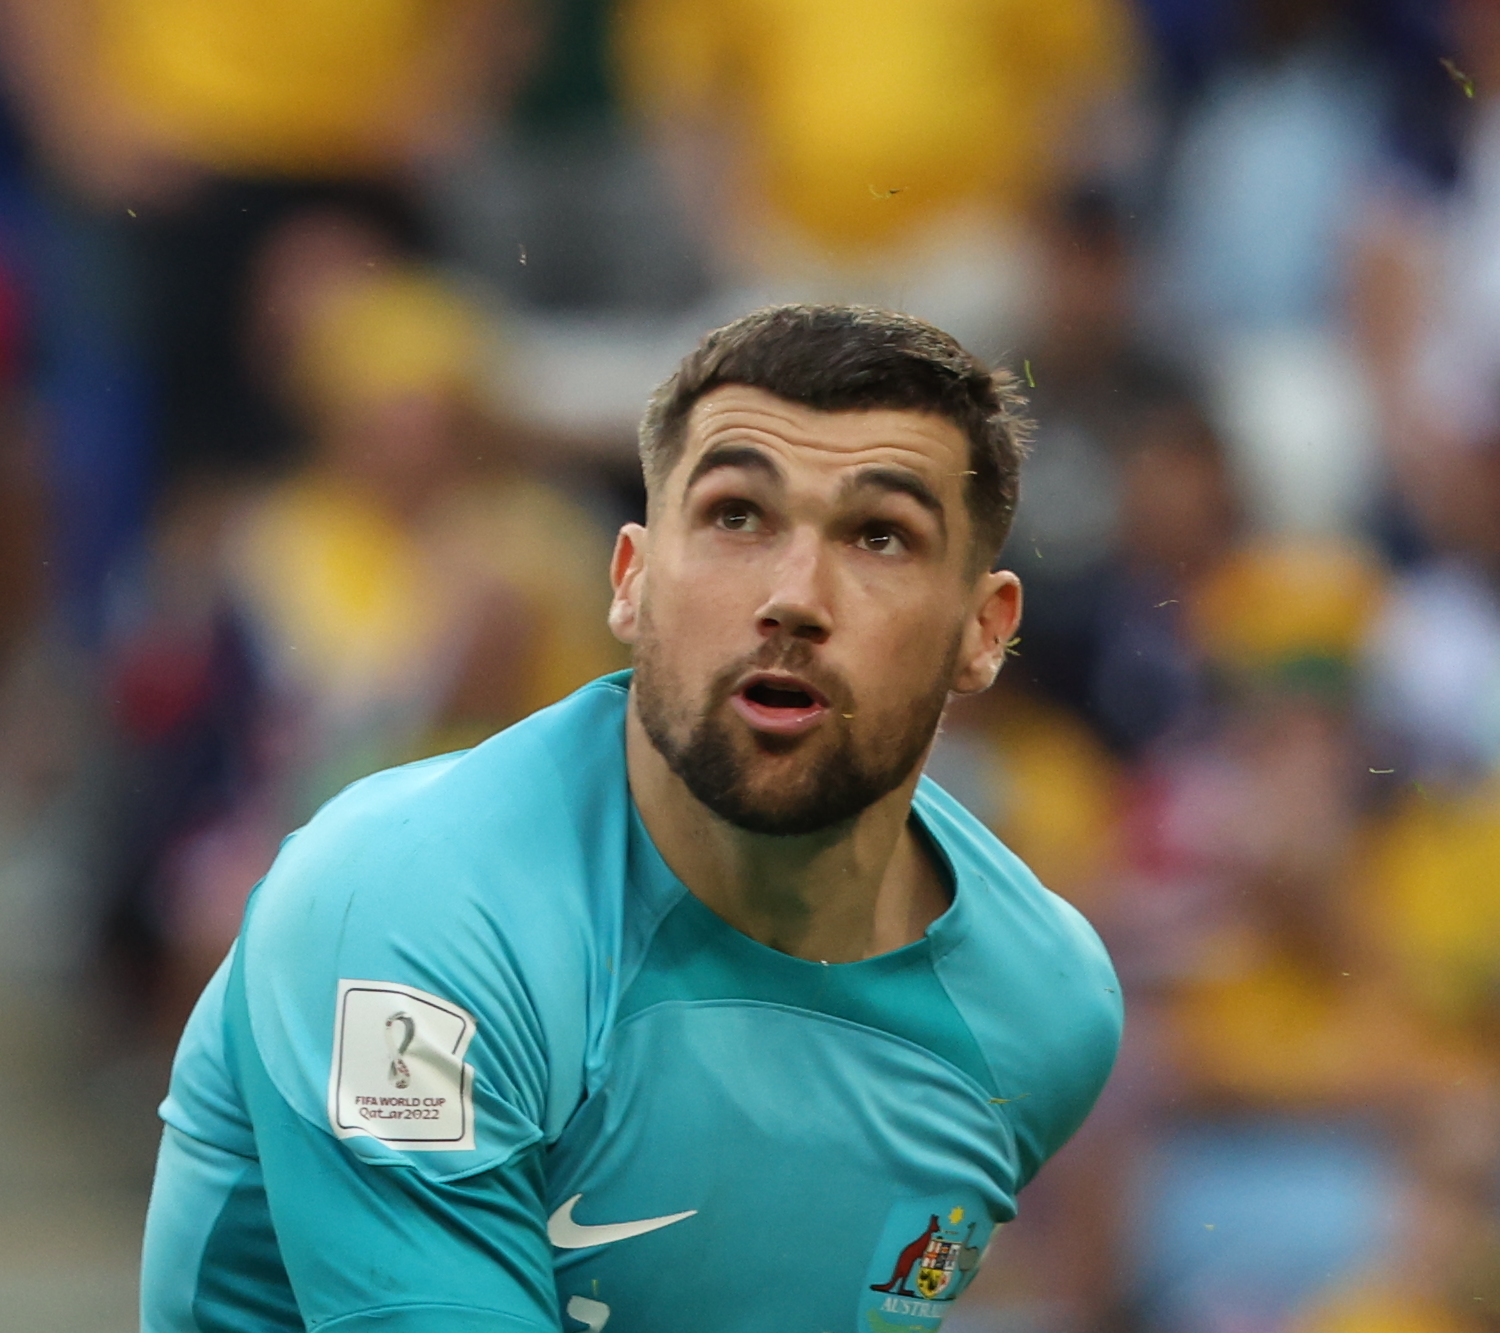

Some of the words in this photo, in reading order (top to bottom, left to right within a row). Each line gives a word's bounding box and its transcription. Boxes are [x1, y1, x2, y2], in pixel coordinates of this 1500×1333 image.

[355, 1096, 378, 1105] FIFA
[379, 1097, 420, 1107] WORLD
[422, 1098, 446, 1108] CUP
